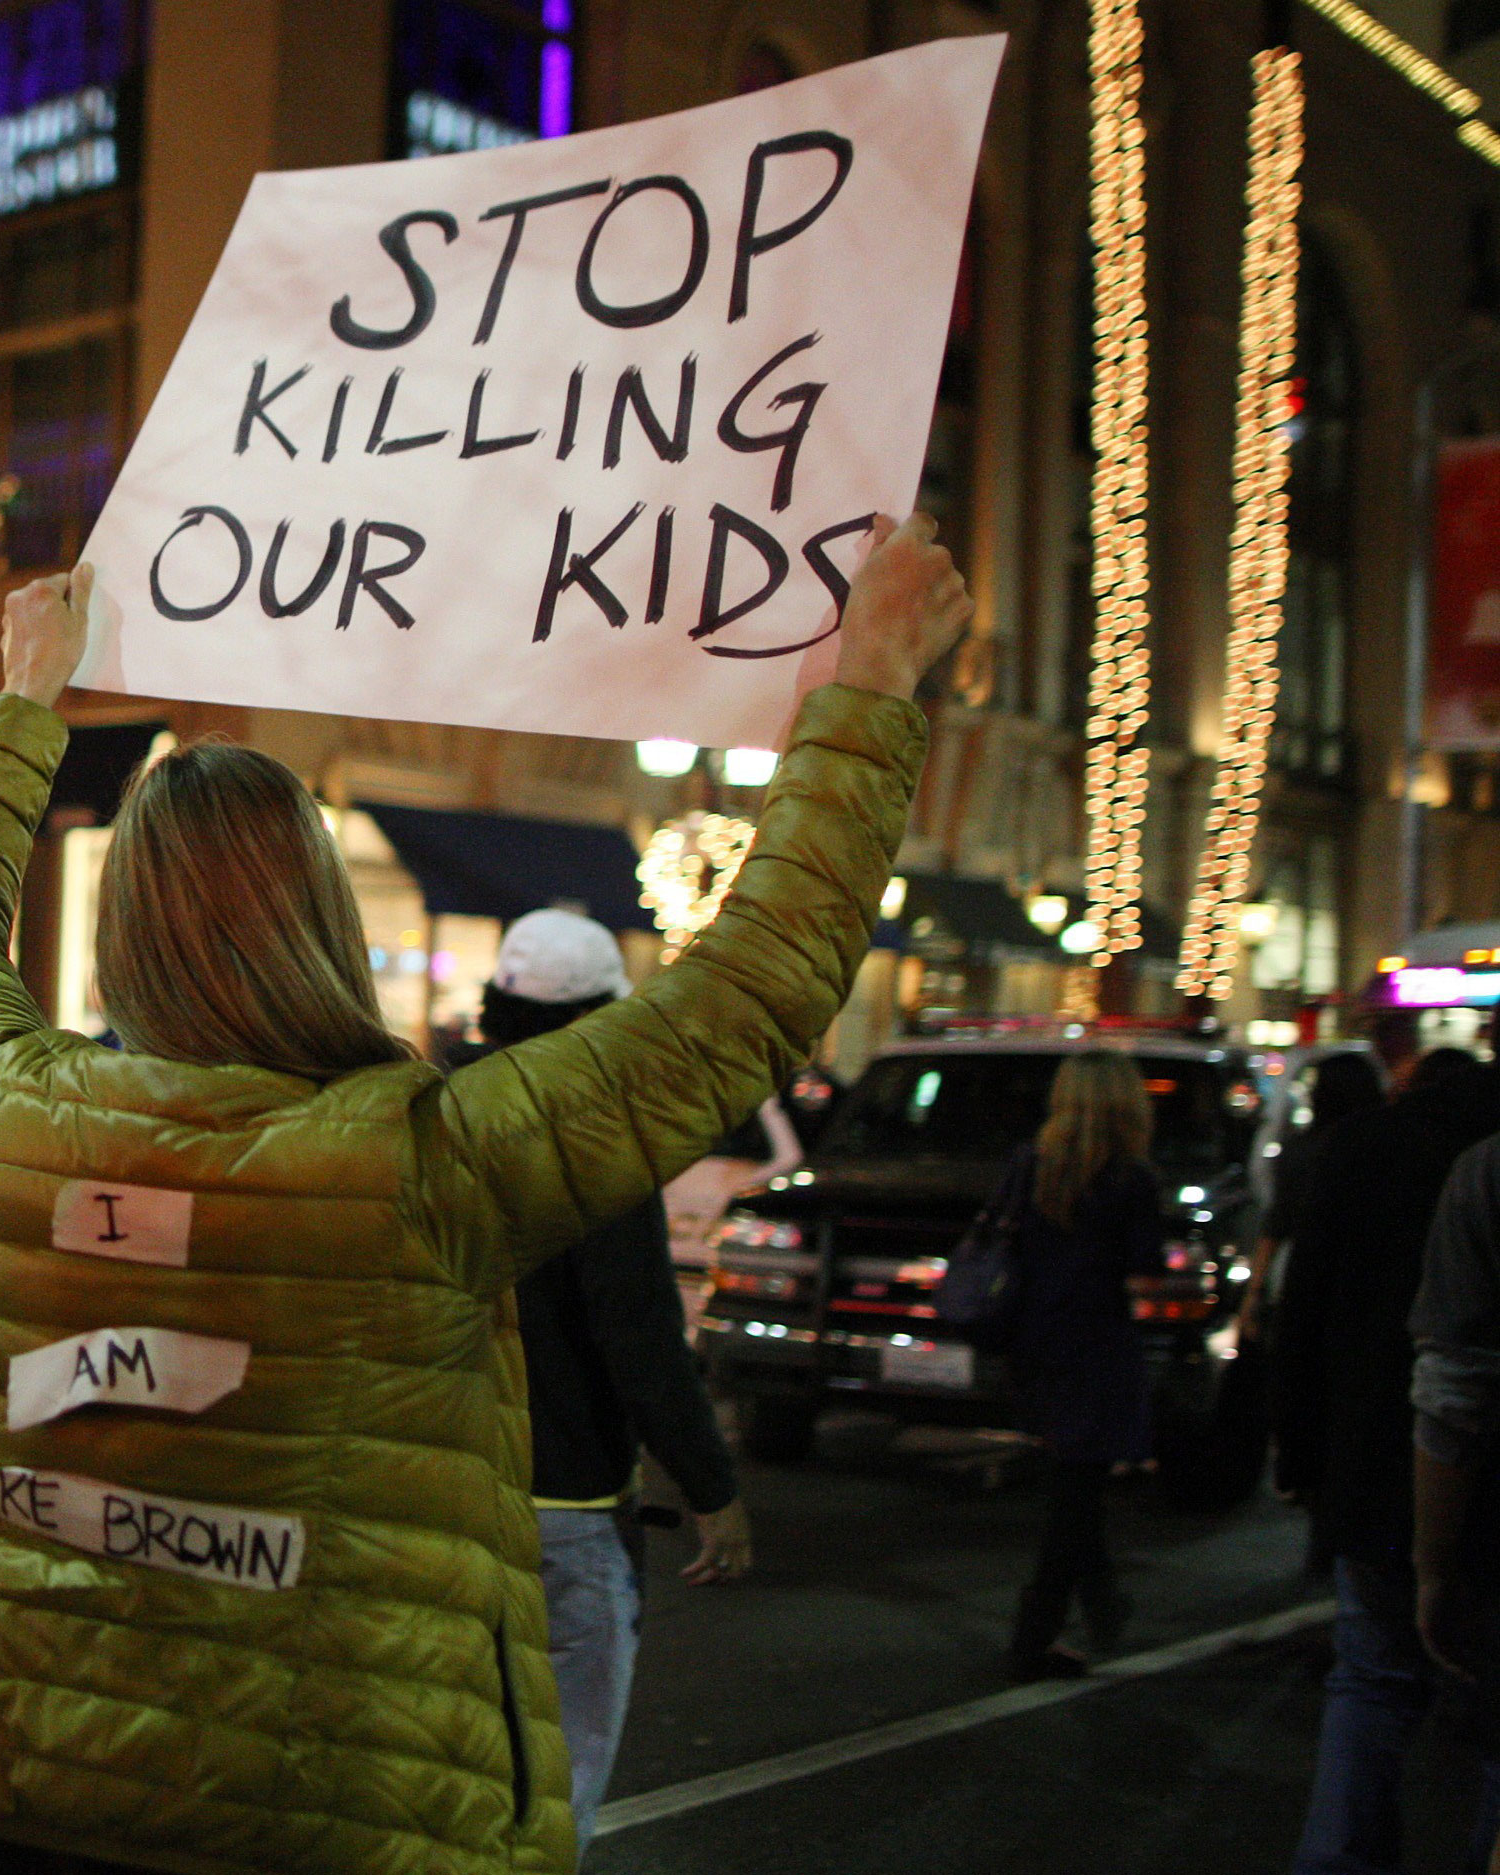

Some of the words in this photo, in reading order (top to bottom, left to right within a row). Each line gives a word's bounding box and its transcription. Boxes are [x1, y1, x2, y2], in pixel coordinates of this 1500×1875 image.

[329, 129, 854, 350] STOP
[232, 331, 830, 512] KILLING
[148, 504, 428, 632] OUR
[531, 500, 878, 660] KIDS
[93, 1193, 129, 1242] I
[68, 1338, 157, 1393] AM
[102, 1494, 293, 1589] BROWN
